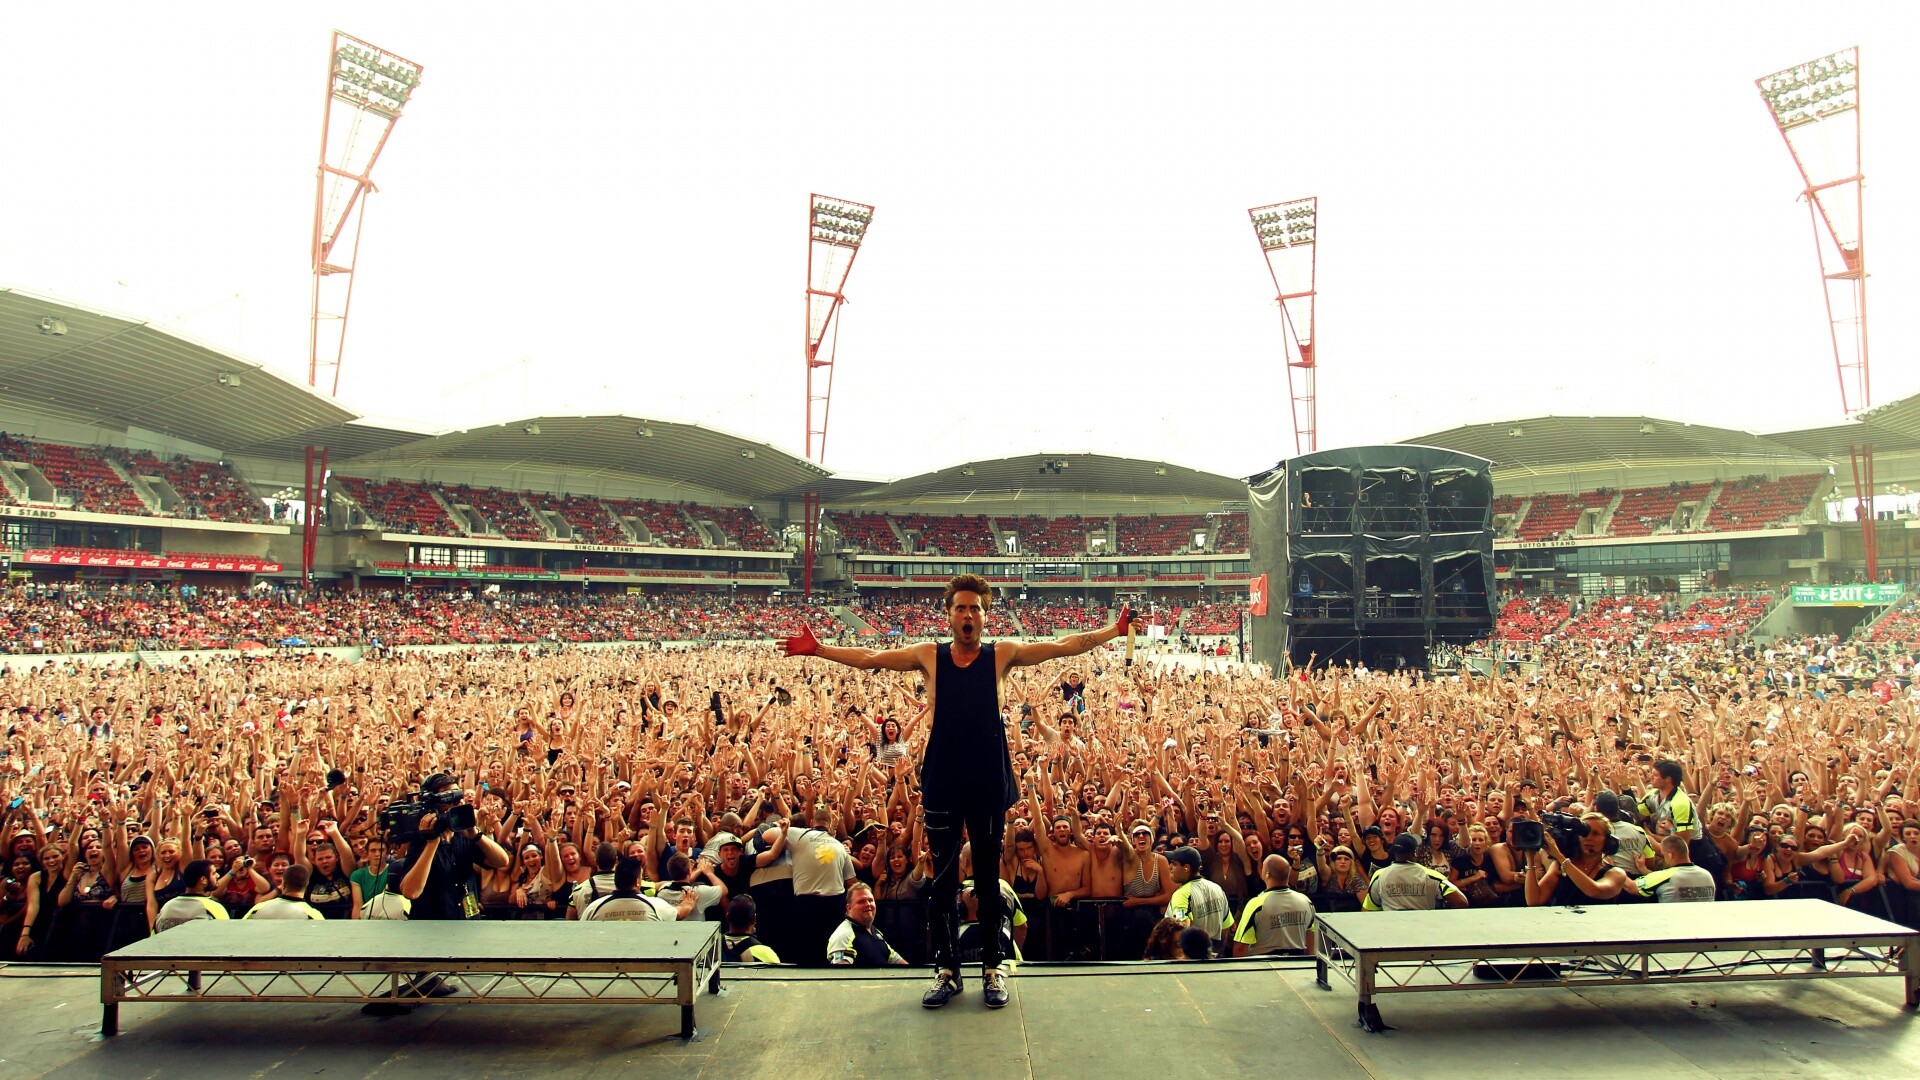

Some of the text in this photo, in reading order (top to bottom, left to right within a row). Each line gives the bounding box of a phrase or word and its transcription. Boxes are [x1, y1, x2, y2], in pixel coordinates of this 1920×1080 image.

[19, 509, 57, 518] STAND
[1830, 588, 1863, 600] EXIT
[1385, 883, 1426, 895] SECURITY
[1270, 911, 1307, 926] SECURITY
